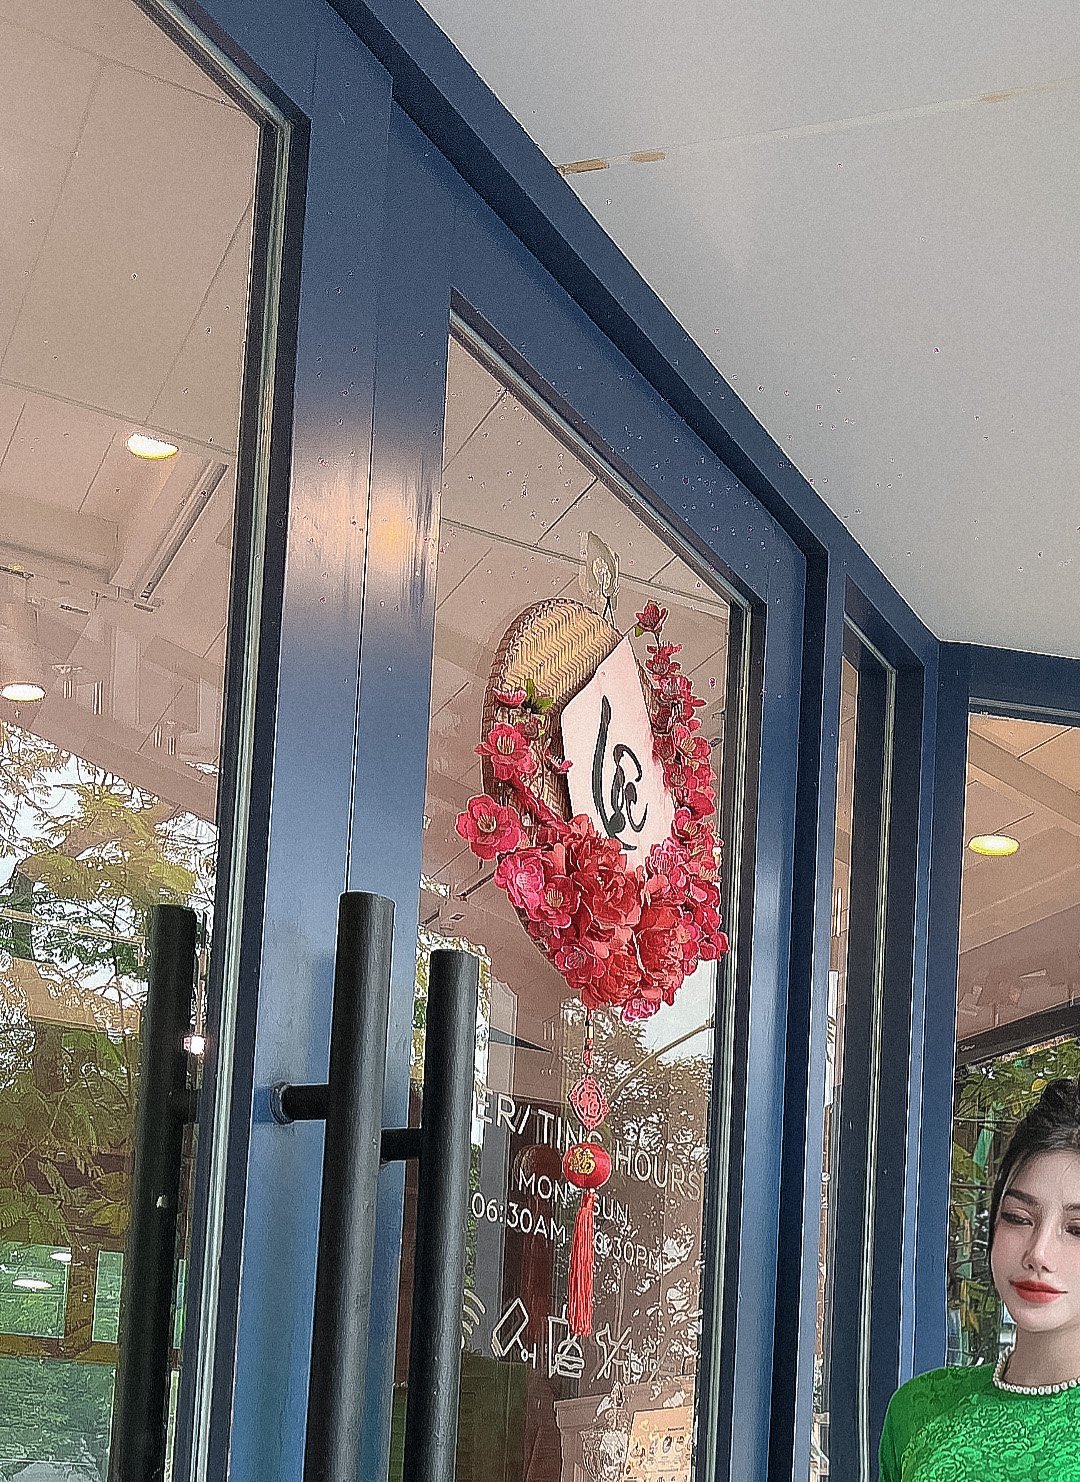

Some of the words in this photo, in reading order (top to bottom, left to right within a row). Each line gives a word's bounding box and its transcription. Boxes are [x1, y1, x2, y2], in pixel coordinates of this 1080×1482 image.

[518, 1166, 567, 1205] MON
[615, 1139, 700, 1200] HOURS
[471, 1192, 566, 1243] 06:30AM
